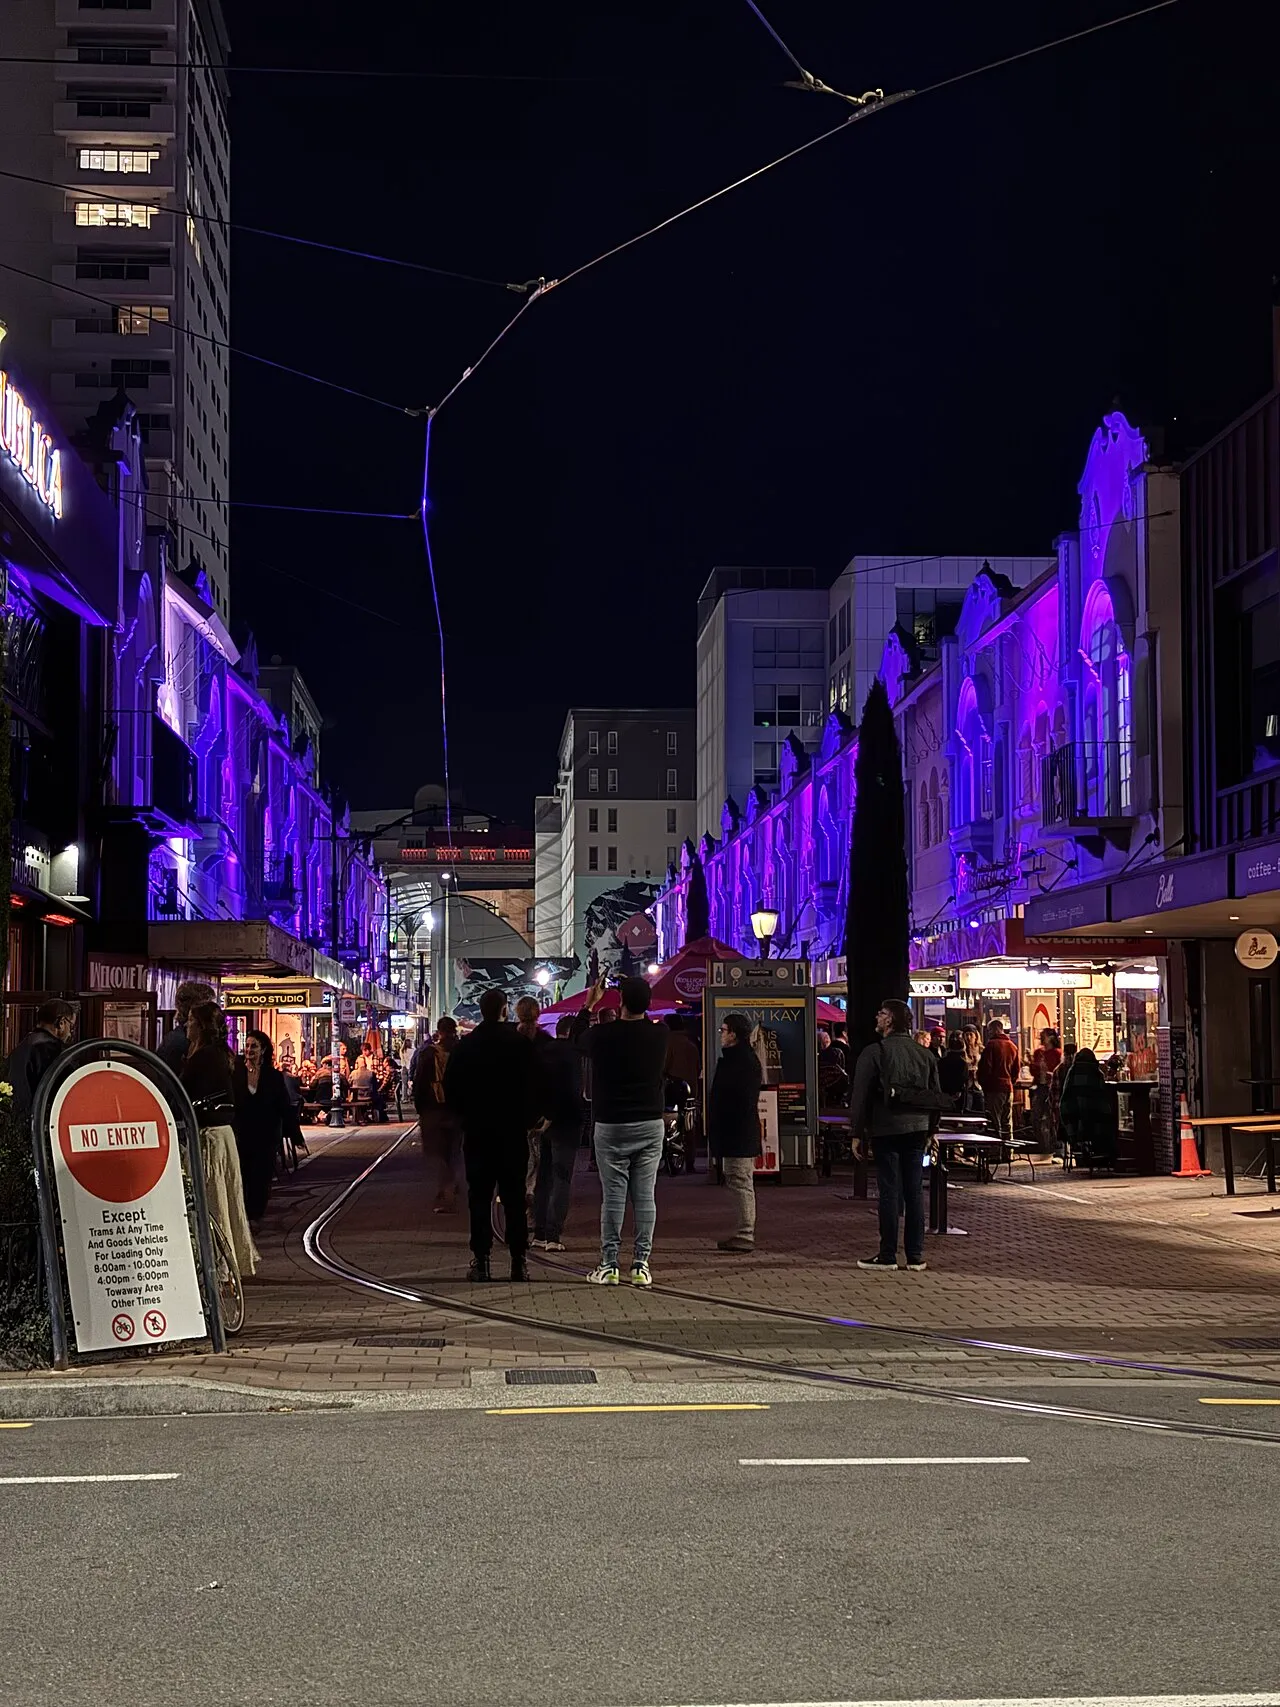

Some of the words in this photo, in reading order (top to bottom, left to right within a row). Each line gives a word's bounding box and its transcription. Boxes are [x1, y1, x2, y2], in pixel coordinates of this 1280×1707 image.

[1156, 873, 1174, 908] Belle
[1248, 944, 1267, 957] Belle
[229, 995, 266, 1004] TATTOO
[268, 994, 304, 1003] STUDIO
[769, 1009, 801, 1022] KAY
[81, 1128, 98, 1147] NO
[107, 1126, 145, 1146] ENTRY
[102, 1208, 146, 1223] Except
[89, 1228, 113, 1237] Trams
[116, 1226, 125, 1235] At
[128, 1225, 142, 1234] Any
[144, 1223, 164, 1232] Time
[88, 1240, 104, 1249] And
[106, 1238, 132, 1248] Goods
[134, 1235, 168, 1245] Vehicles
[95, 1252, 108, 1261] For
[111, 1249, 143, 1259] Loading
[145, 1247, 163, 1257] Only
[94, 1263, 126, 1273] 8:00am
[133, 1259, 169, 1270] 10:00am
[97, 1275, 130, 1285] 4:00pm
[137, 1271, 169, 1281] 6:00pm
[105, 1286, 143, 1297] Towaway
[145, 1284, 164, 1293] Area
[111, 1299, 135, 1309] Other
[136, 1296, 162, 1306] Times
